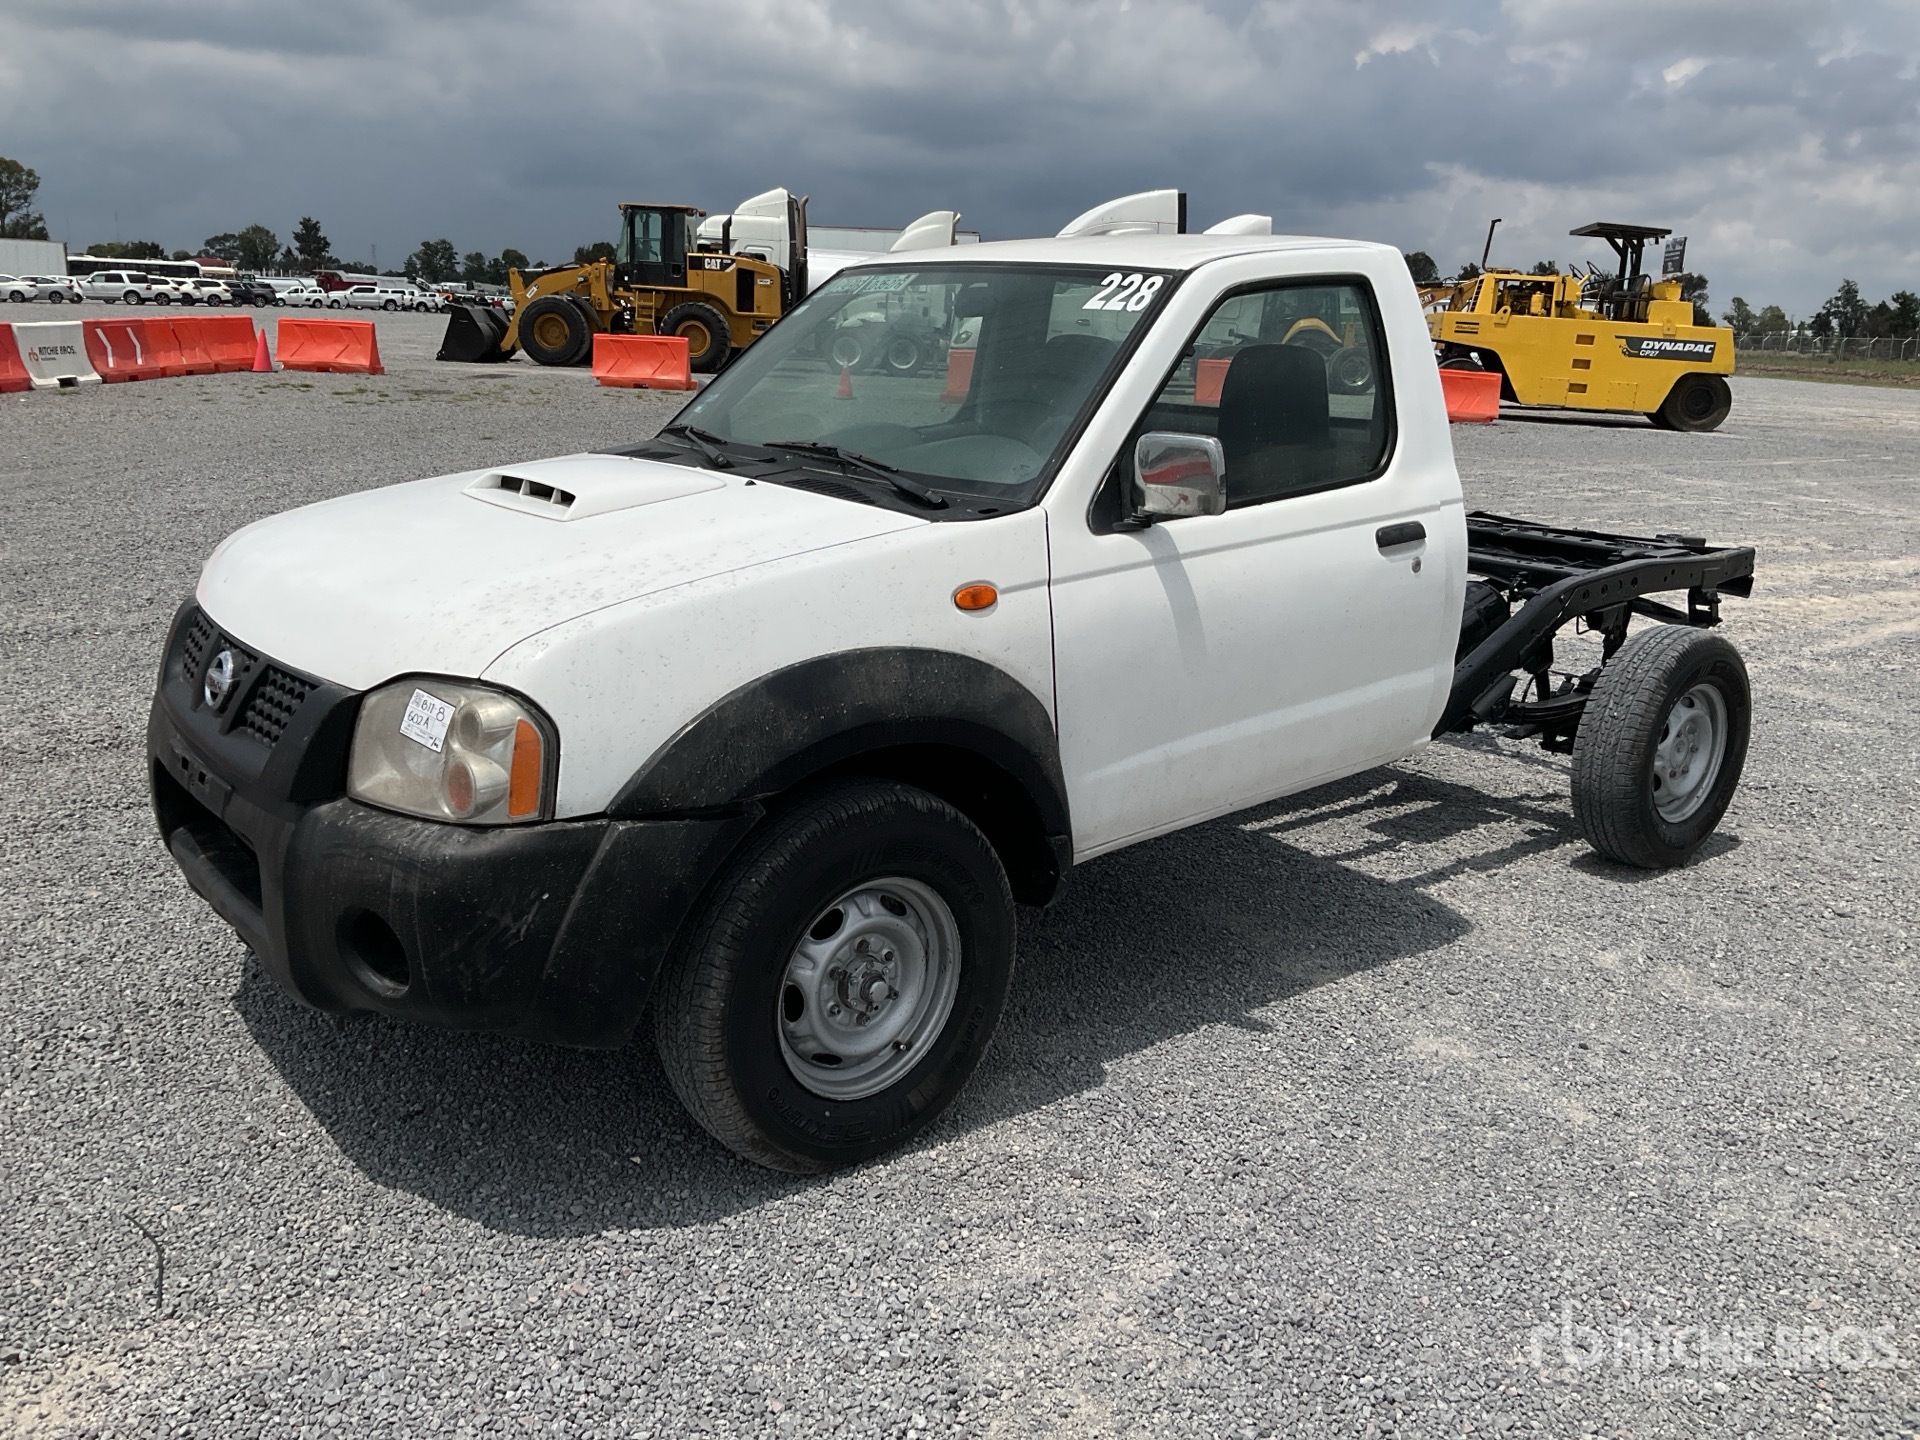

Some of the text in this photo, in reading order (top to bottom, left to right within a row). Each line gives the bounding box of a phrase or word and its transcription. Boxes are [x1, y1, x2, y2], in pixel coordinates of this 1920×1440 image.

[704, 258, 721, 269] CAT
[1082, 272, 1164, 312] 228
[1641, 340, 1714, 353] DYNAPAC
